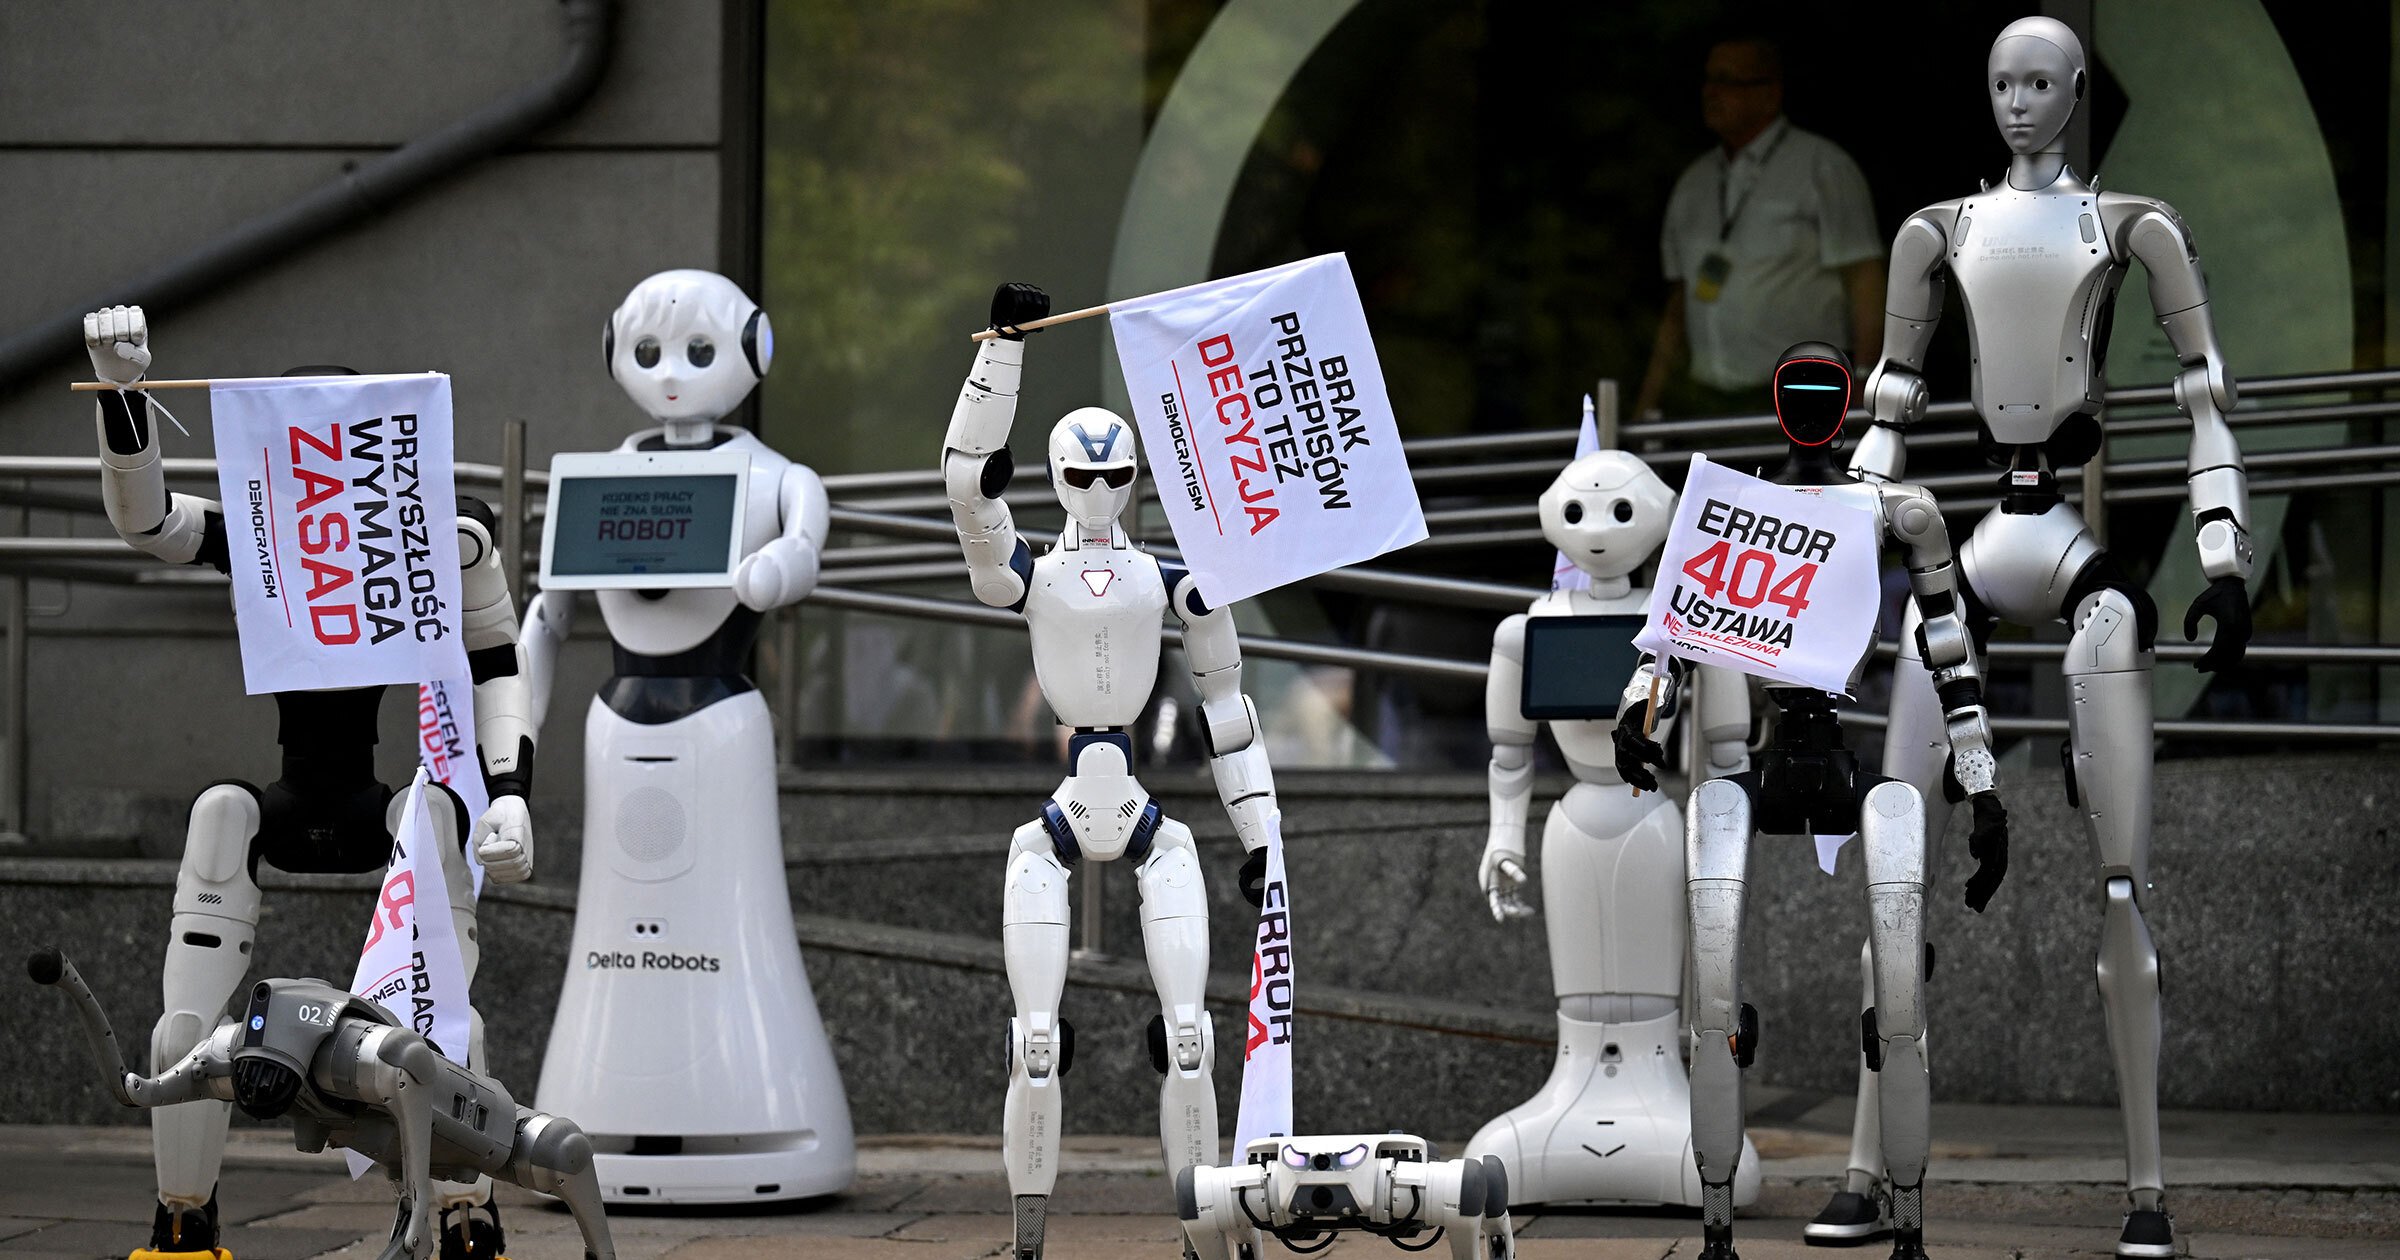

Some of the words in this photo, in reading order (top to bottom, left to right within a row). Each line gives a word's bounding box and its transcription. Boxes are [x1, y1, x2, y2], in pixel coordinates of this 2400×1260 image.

[1249, 360, 1283, 410] TO
[1270, 311, 1351, 509] PRZEPISÓW
[1319, 355, 1370, 453] BRAK
[1161, 392, 1205, 511] DEMOCRATISM
[1197, 333, 1280, 536] DECYZJA
[1264, 414, 1309, 484] TEŻ
[288, 423, 361, 646] ZASAD
[349, 417, 406, 646] WYMAGA
[391, 414, 450, 643] PRZYSZŁOŚĆ
[597, 518, 692, 541] ROBOT
[601, 505, 620, 516] NIE
[623, 505, 648, 516] ZNA
[602, 491, 650, 503] KODEKS
[653, 491, 694, 502] PRACY
[1697, 498, 1836, 563] ERROR
[248, 479, 278, 599] DEMOCRATISM
[1670, 584, 1793, 649] USTAWA
[1682, 540, 1819, 619] 404
[587, 951, 635, 969] Delta
[642, 951, 720, 972] Robots
[1260, 881, 1292, 1045] ERROR
[298, 1004, 321, 1023] 02
